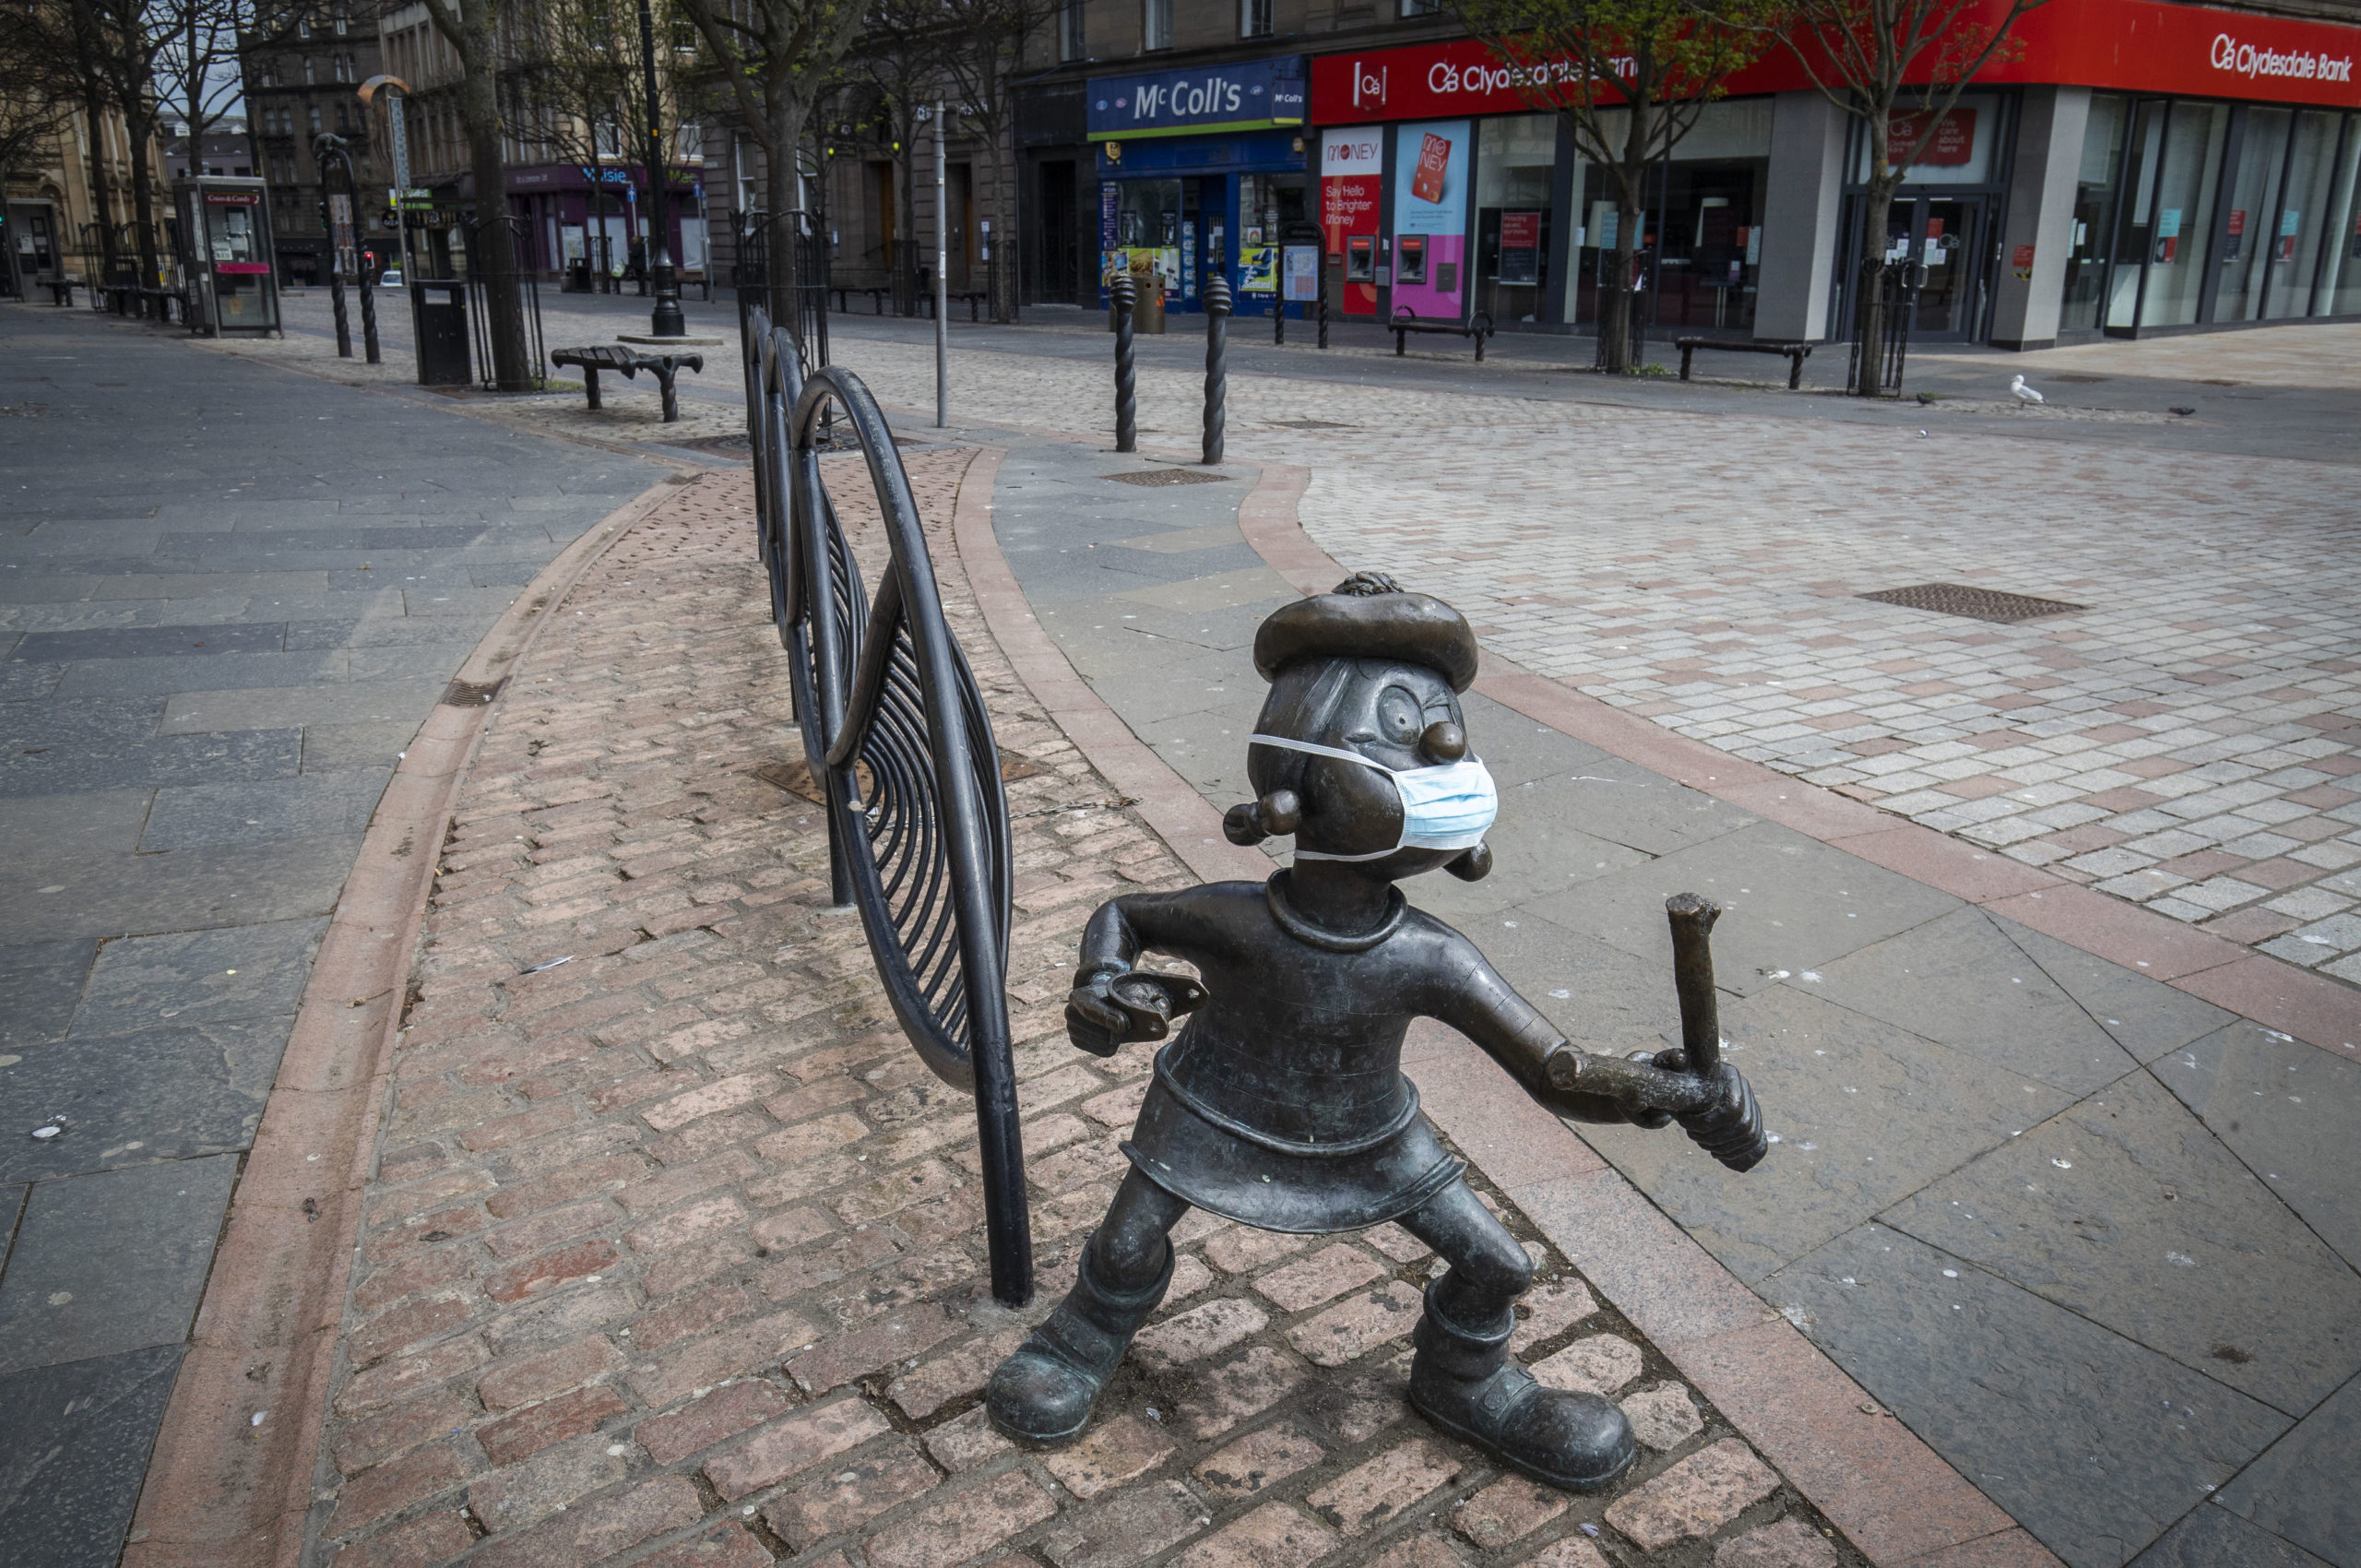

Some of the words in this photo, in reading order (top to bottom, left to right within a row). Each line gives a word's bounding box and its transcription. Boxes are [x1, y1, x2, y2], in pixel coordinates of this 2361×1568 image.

[2236, 43, 2317, 79] Clydesdale
[2317, 53, 2354, 82] Bank
[582, 167, 627, 184] Misie
[1325, 185, 1341, 198] Say
[1342, 184, 1365, 196] Hello
[1325, 200, 1336, 211] to
[1337, 199, 1372, 213] Brighter
[1325, 213, 1355, 227] Money
